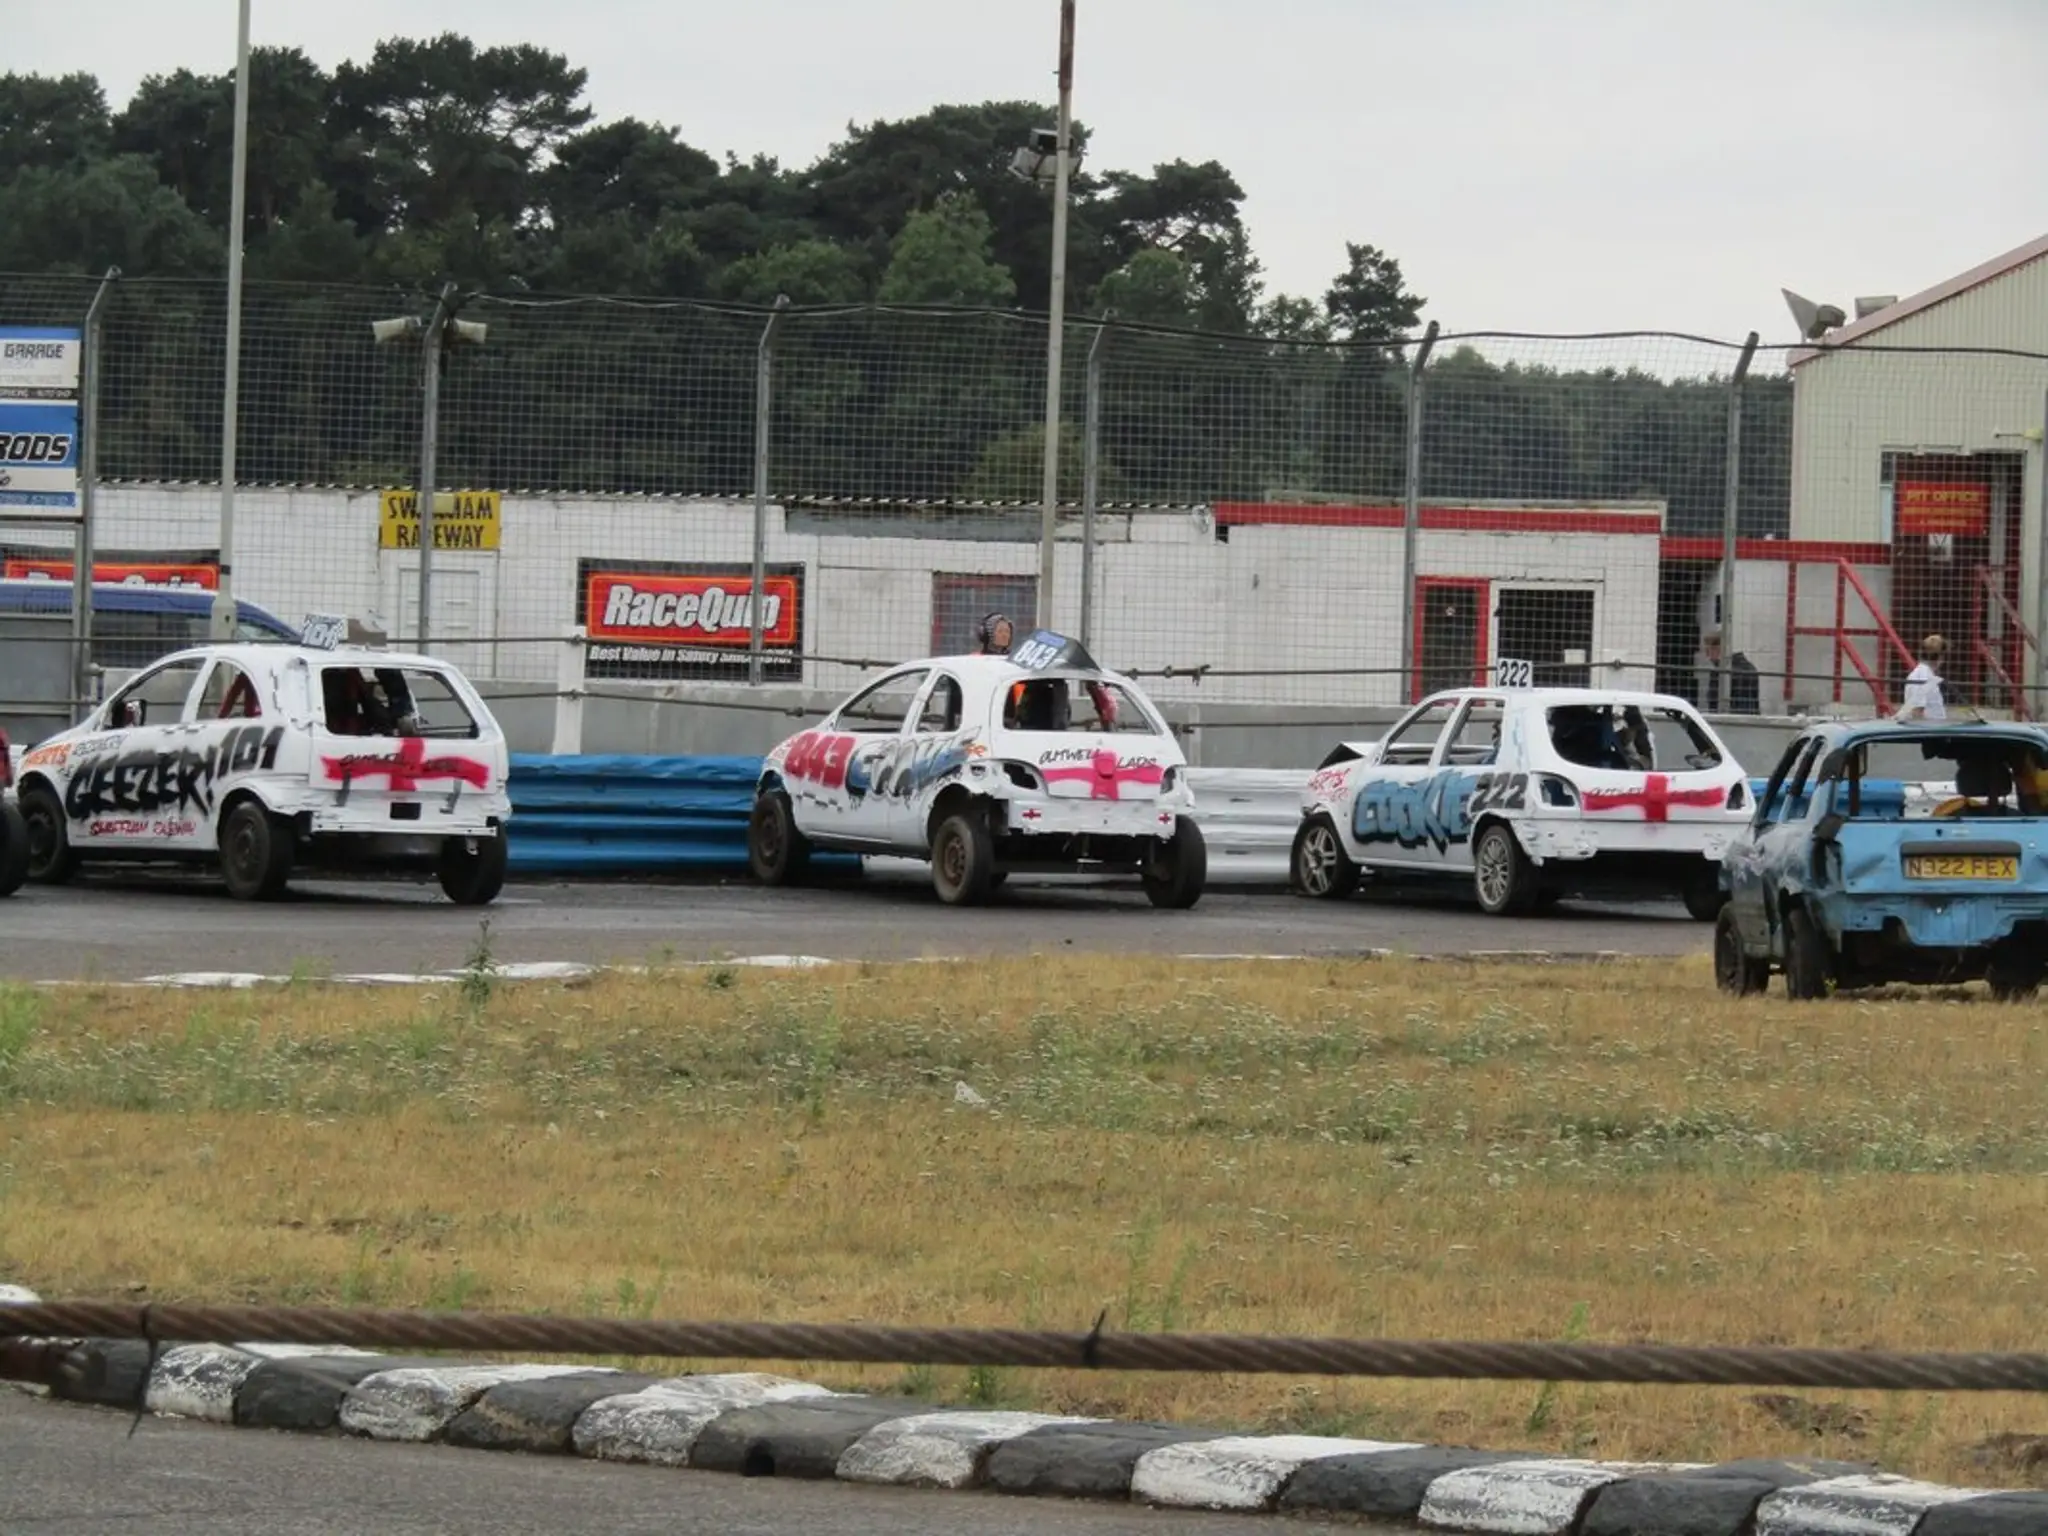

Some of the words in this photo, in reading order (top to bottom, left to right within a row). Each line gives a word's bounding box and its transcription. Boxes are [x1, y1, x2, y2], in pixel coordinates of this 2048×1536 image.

[4, 343, 65, 358] GARAGE
[396, 524, 483, 548] RAEWAY
[1014, 640, 1058, 670] 843
[1500, 660, 1529, 687] 222
[217, 726, 285, 780] 101
[784, 731, 857, 789] 843
[1469, 772, 1529, 813] 222
[1971, 857, 2014, 877] FEX
